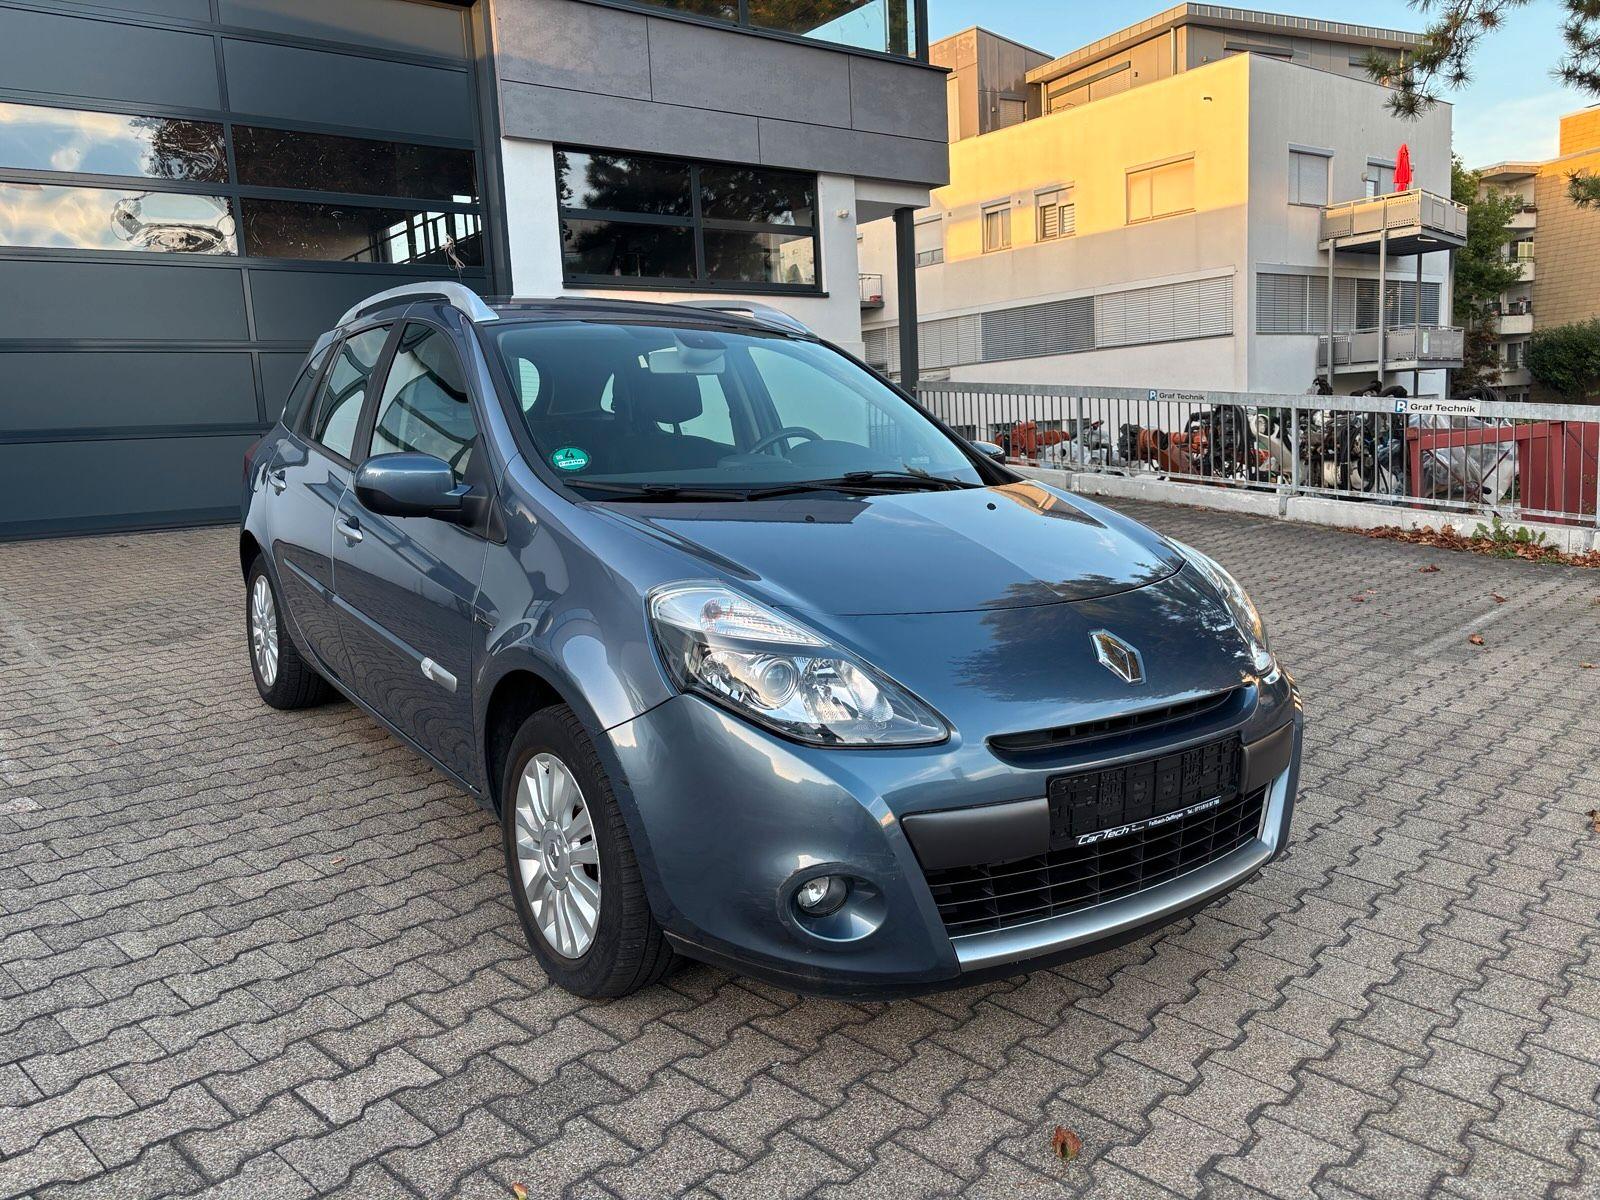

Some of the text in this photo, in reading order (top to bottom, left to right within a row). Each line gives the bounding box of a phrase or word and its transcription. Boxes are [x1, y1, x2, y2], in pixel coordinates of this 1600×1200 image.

[1177, 393, 1205, 401] Technik
[1410, 403, 1433, 411] Graf
[1436, 404, 1477, 413] Technik
[565, 450, 575, 459] 4
[1078, 826, 1130, 845] CarTech
